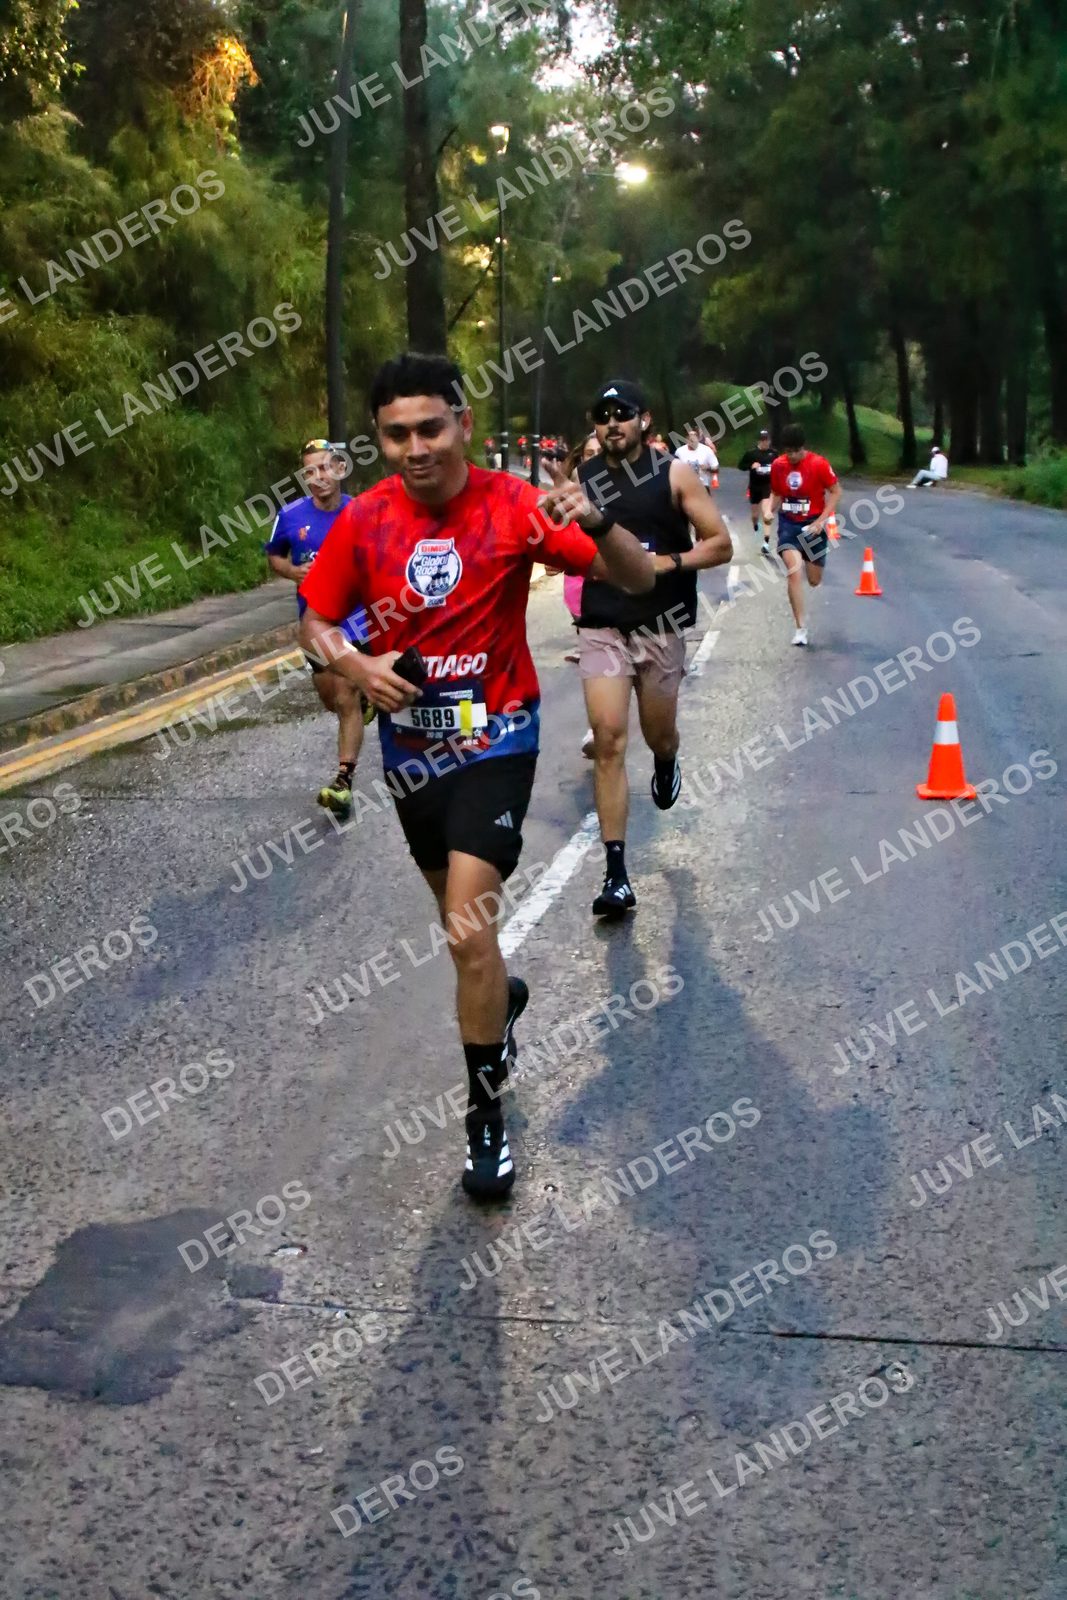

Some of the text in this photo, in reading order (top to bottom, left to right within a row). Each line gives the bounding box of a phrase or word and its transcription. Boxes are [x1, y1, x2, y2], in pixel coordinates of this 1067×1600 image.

[421, 555, 449, 566] Global
[415, 565, 438, 576] Race
[422, 652, 488, 678] TIAGO
[410, 709, 455, 728] 5689
